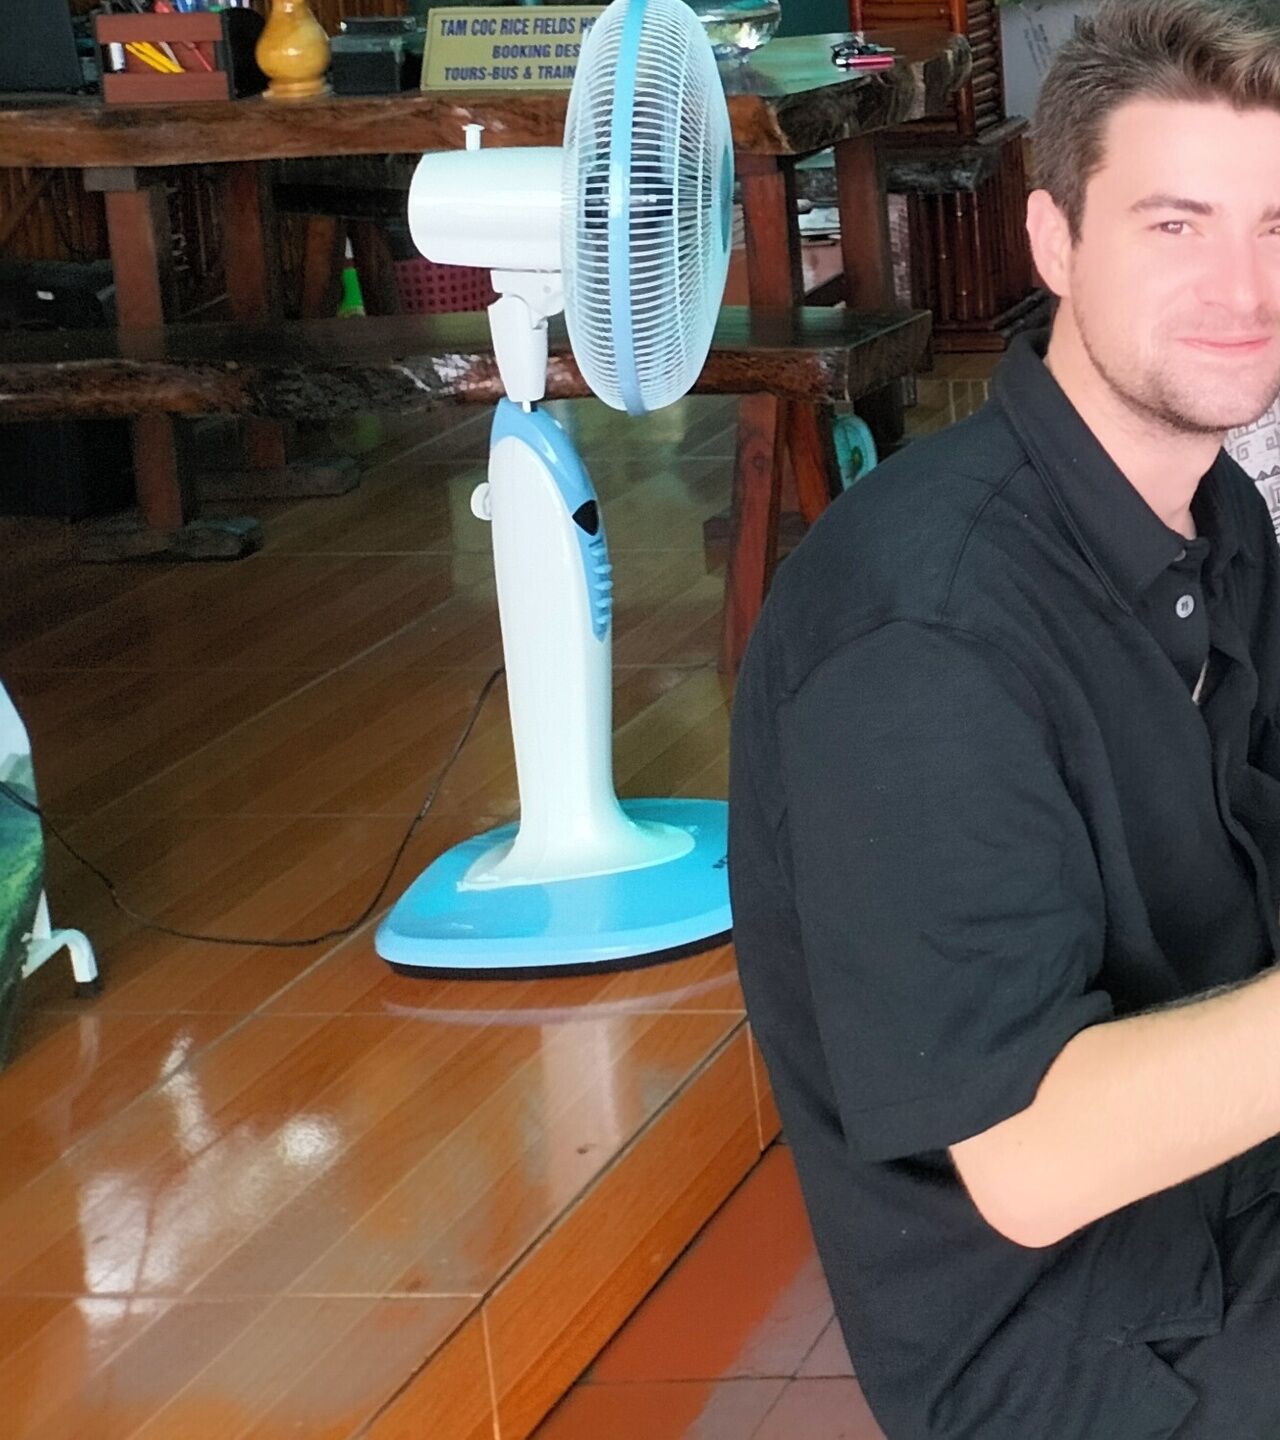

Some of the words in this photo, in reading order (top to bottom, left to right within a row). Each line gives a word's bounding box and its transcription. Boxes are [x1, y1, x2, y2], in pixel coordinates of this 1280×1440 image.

[441, 19, 468, 36] TAM
[471, 19, 497, 36] COC
[500, 18, 530, 36] RICE
[533, 17, 575, 35] FIELDS
[492, 44, 551, 59] BOOKING
[445, 66, 518, 81] TOURS-BUS
[523, 66, 532, 79] &
